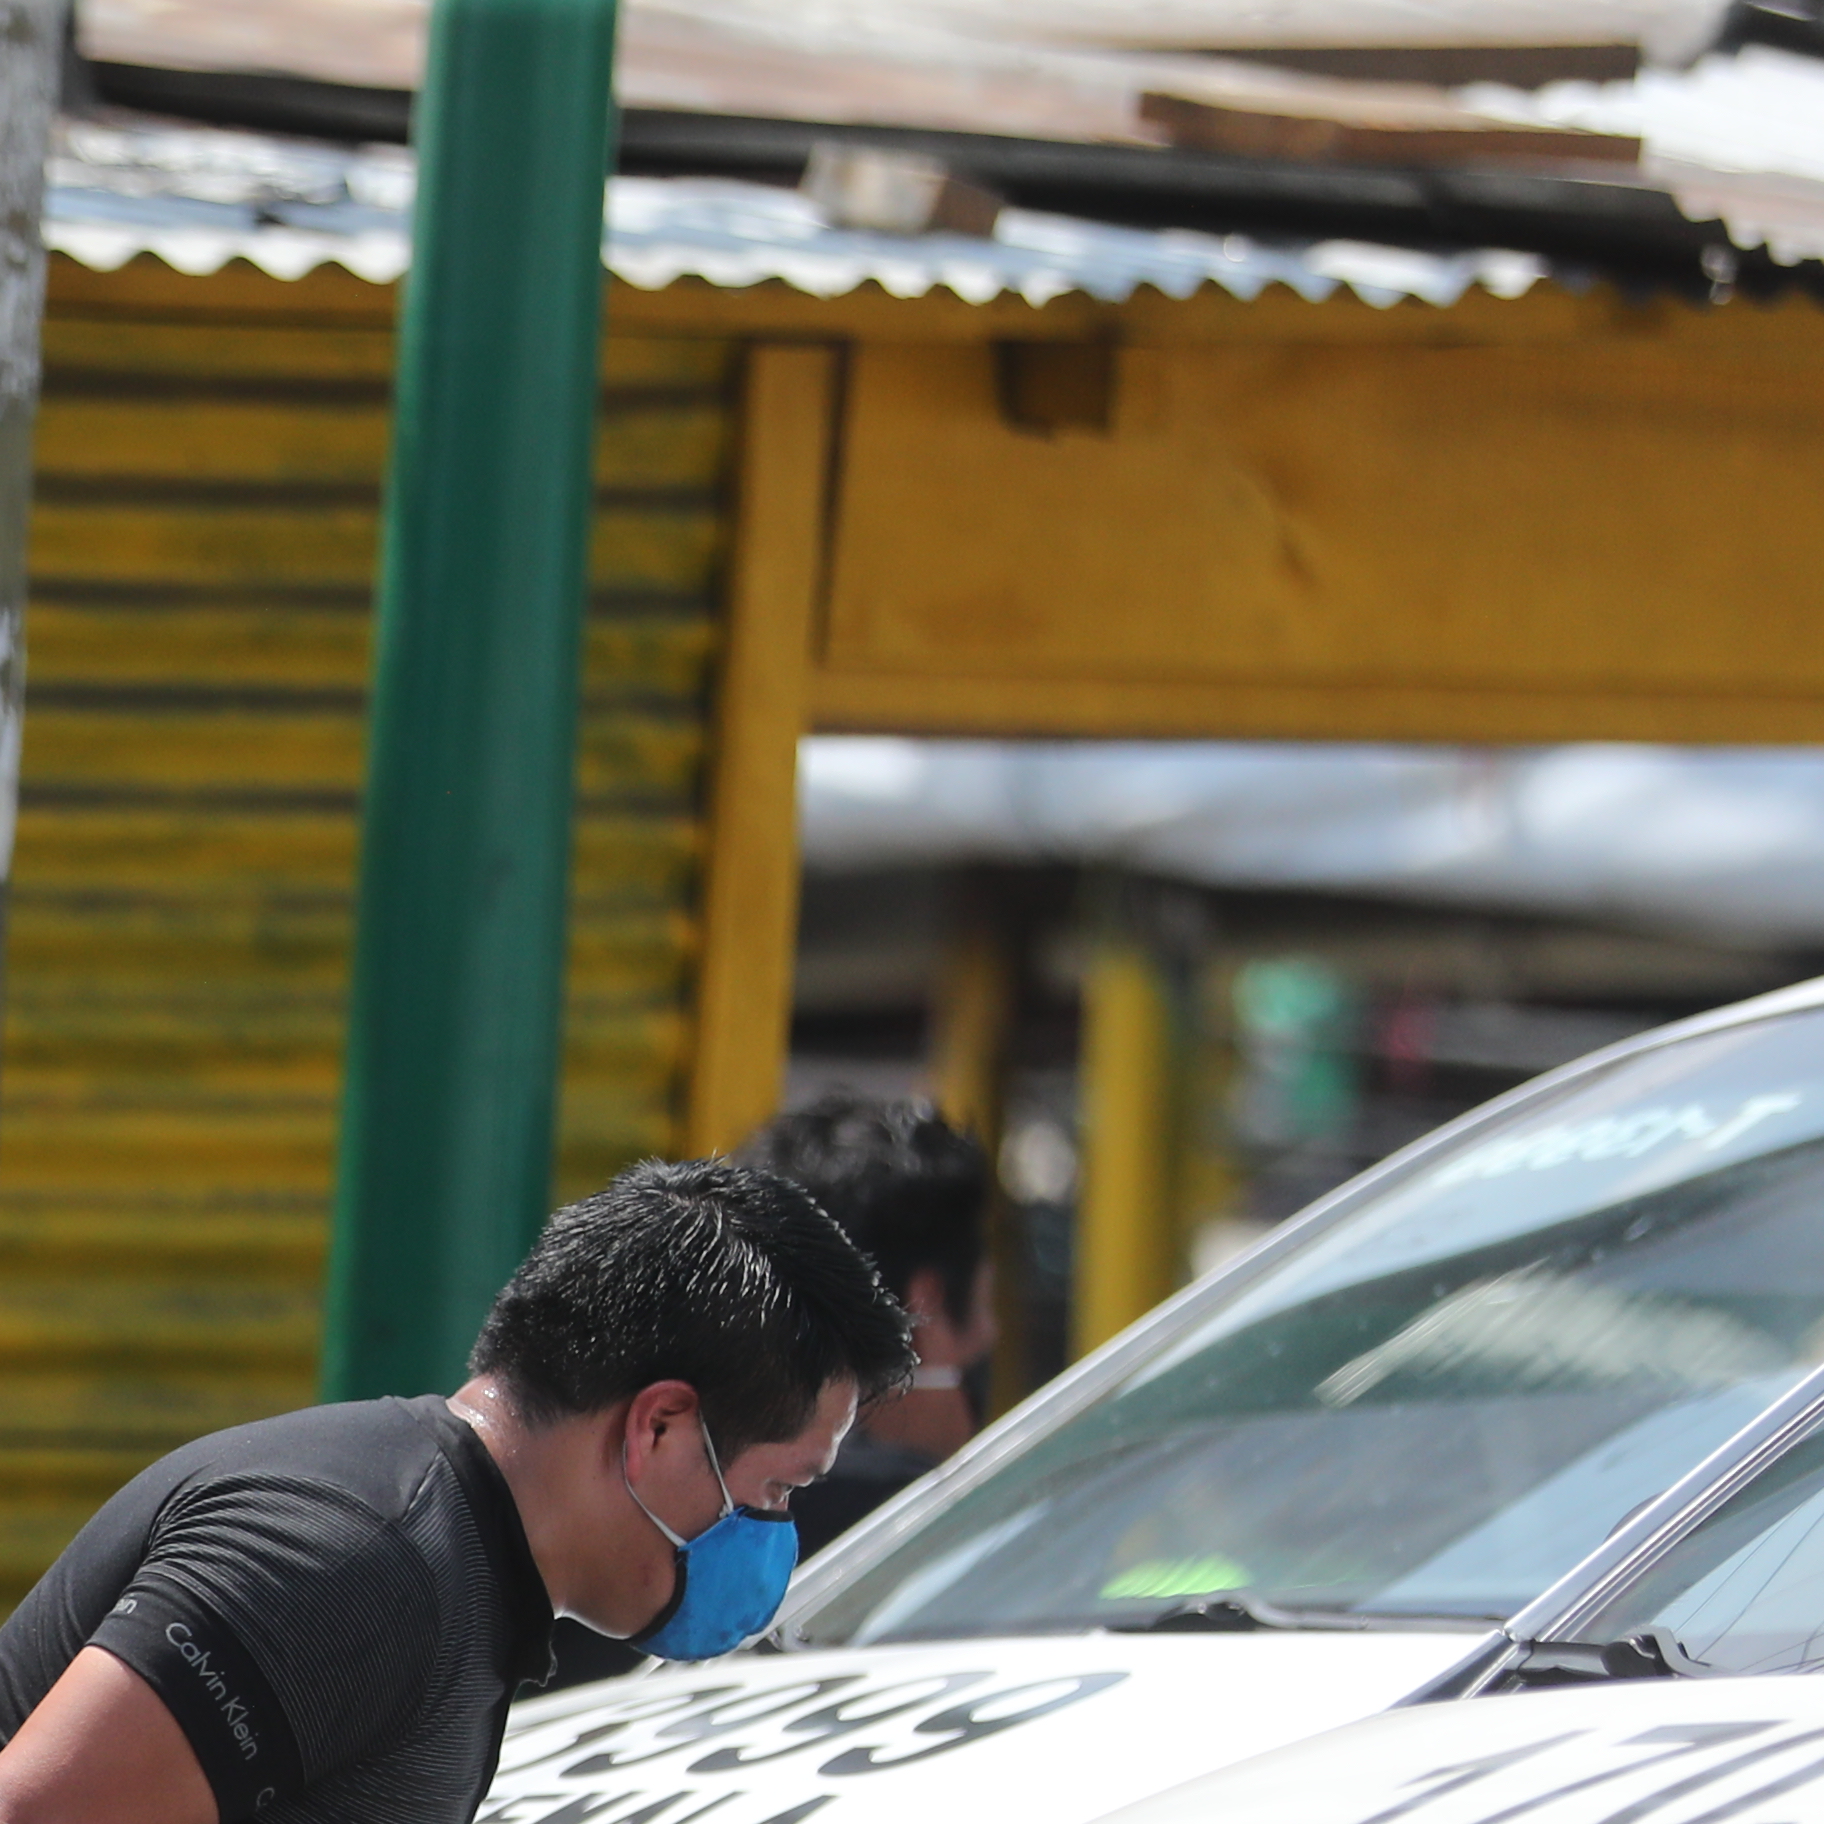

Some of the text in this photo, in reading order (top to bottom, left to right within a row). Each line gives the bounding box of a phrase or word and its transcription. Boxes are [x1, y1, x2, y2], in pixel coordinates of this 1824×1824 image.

[165, 1622, 259, 1761] Calvin Klein
[496, 1671, 1132, 1778] 3999
